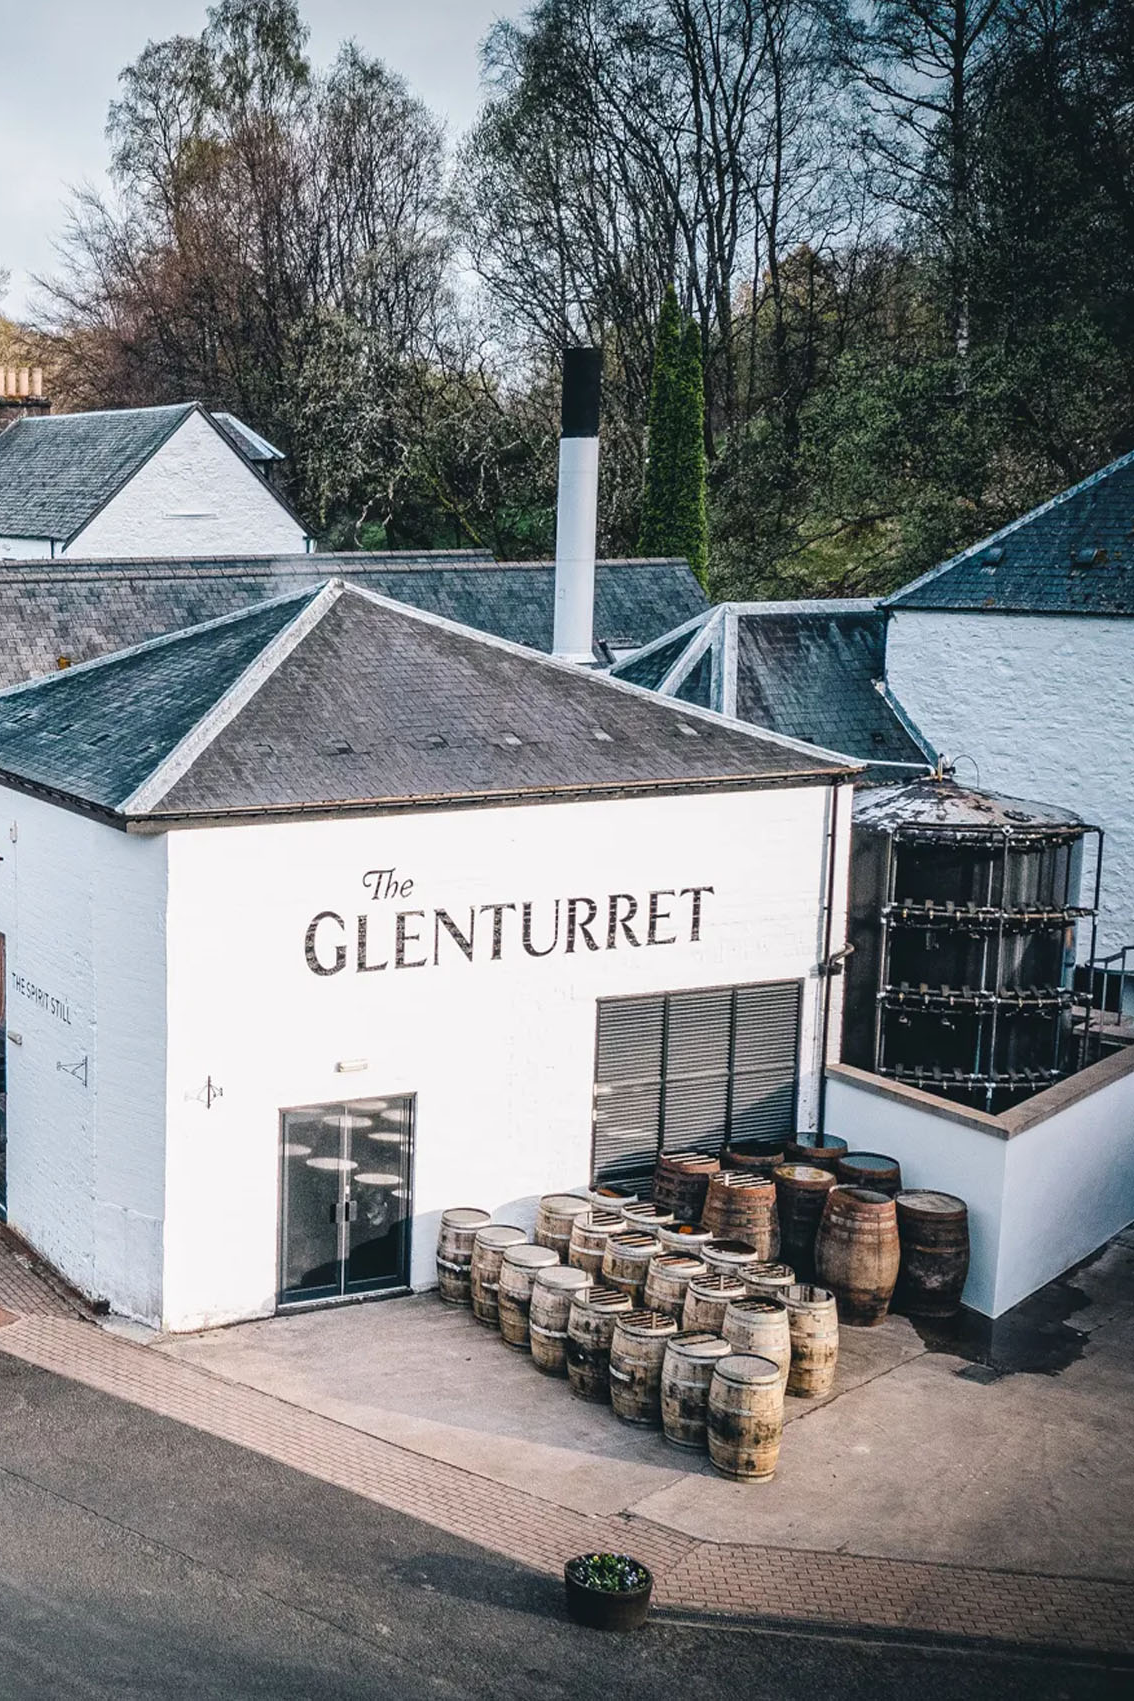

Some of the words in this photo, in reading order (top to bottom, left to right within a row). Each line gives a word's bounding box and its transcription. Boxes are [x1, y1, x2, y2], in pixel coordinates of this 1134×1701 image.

[362, 867, 414, 900] The
[304, 886, 714, 977] GLENTURRET
[12, 972, 25, 995] THE
[26, 981, 49, 1010] SPIRIT
[51, 998, 71, 1025] STILL
